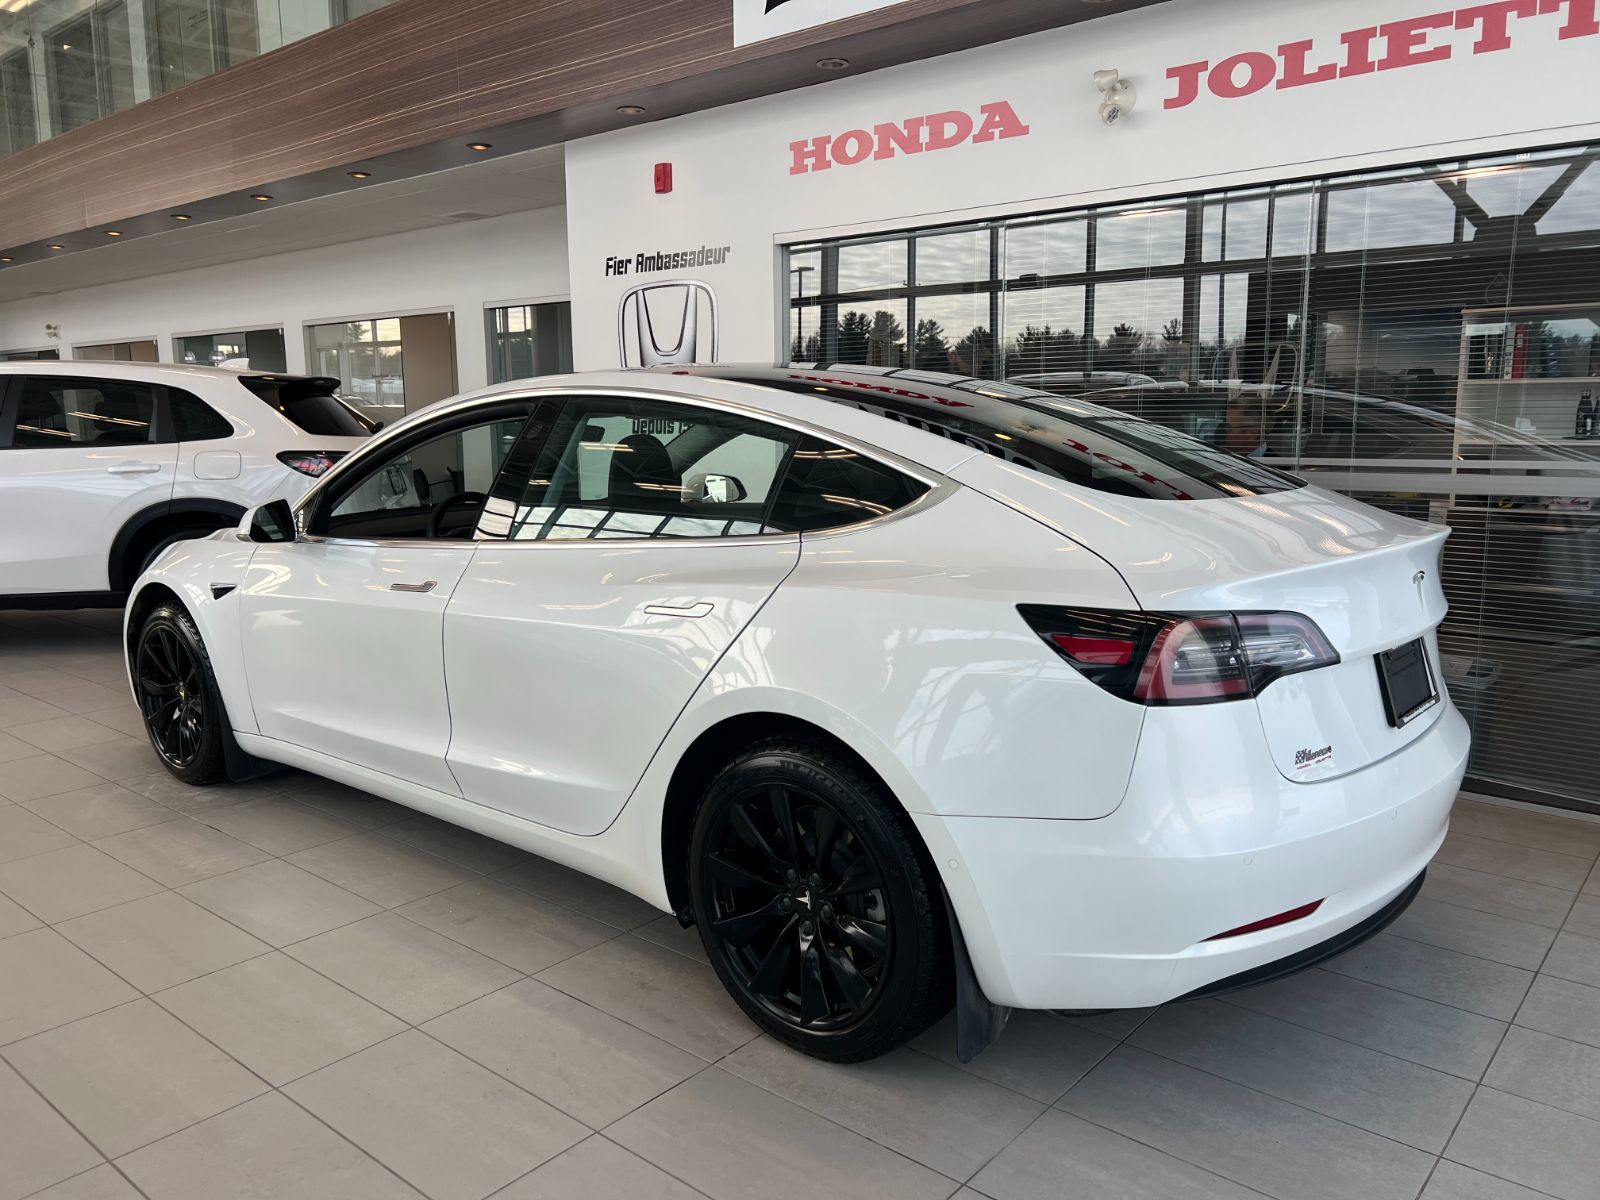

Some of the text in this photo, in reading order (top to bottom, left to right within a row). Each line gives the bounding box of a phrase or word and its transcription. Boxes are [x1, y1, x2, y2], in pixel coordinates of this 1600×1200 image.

[789, 100, 1030, 176] HONDA
[605, 245, 730, 276] Fier Ambassadeur
